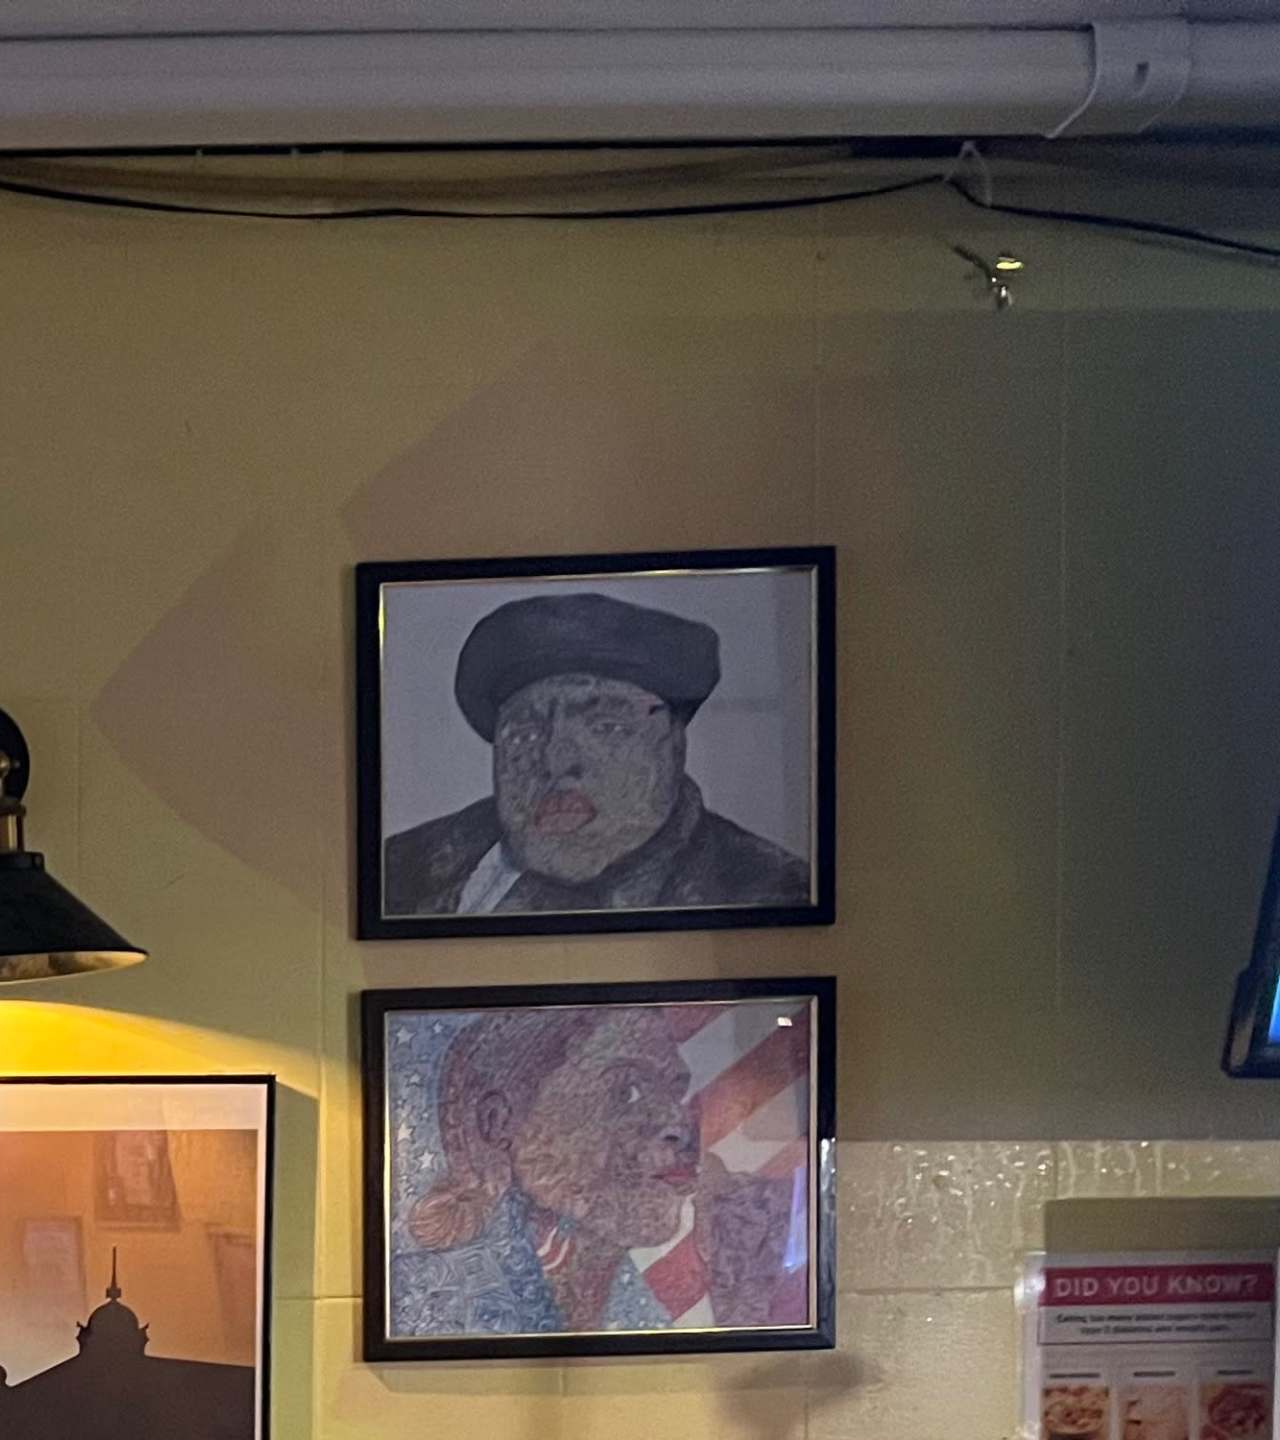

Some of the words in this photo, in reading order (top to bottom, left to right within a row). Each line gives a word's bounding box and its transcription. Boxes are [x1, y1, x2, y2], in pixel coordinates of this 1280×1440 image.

[1055, 1277, 1099, 1297] DID
[1108, 1276, 1159, 1296] YOU
[1167, 1274, 1259, 1294] KNOW?
